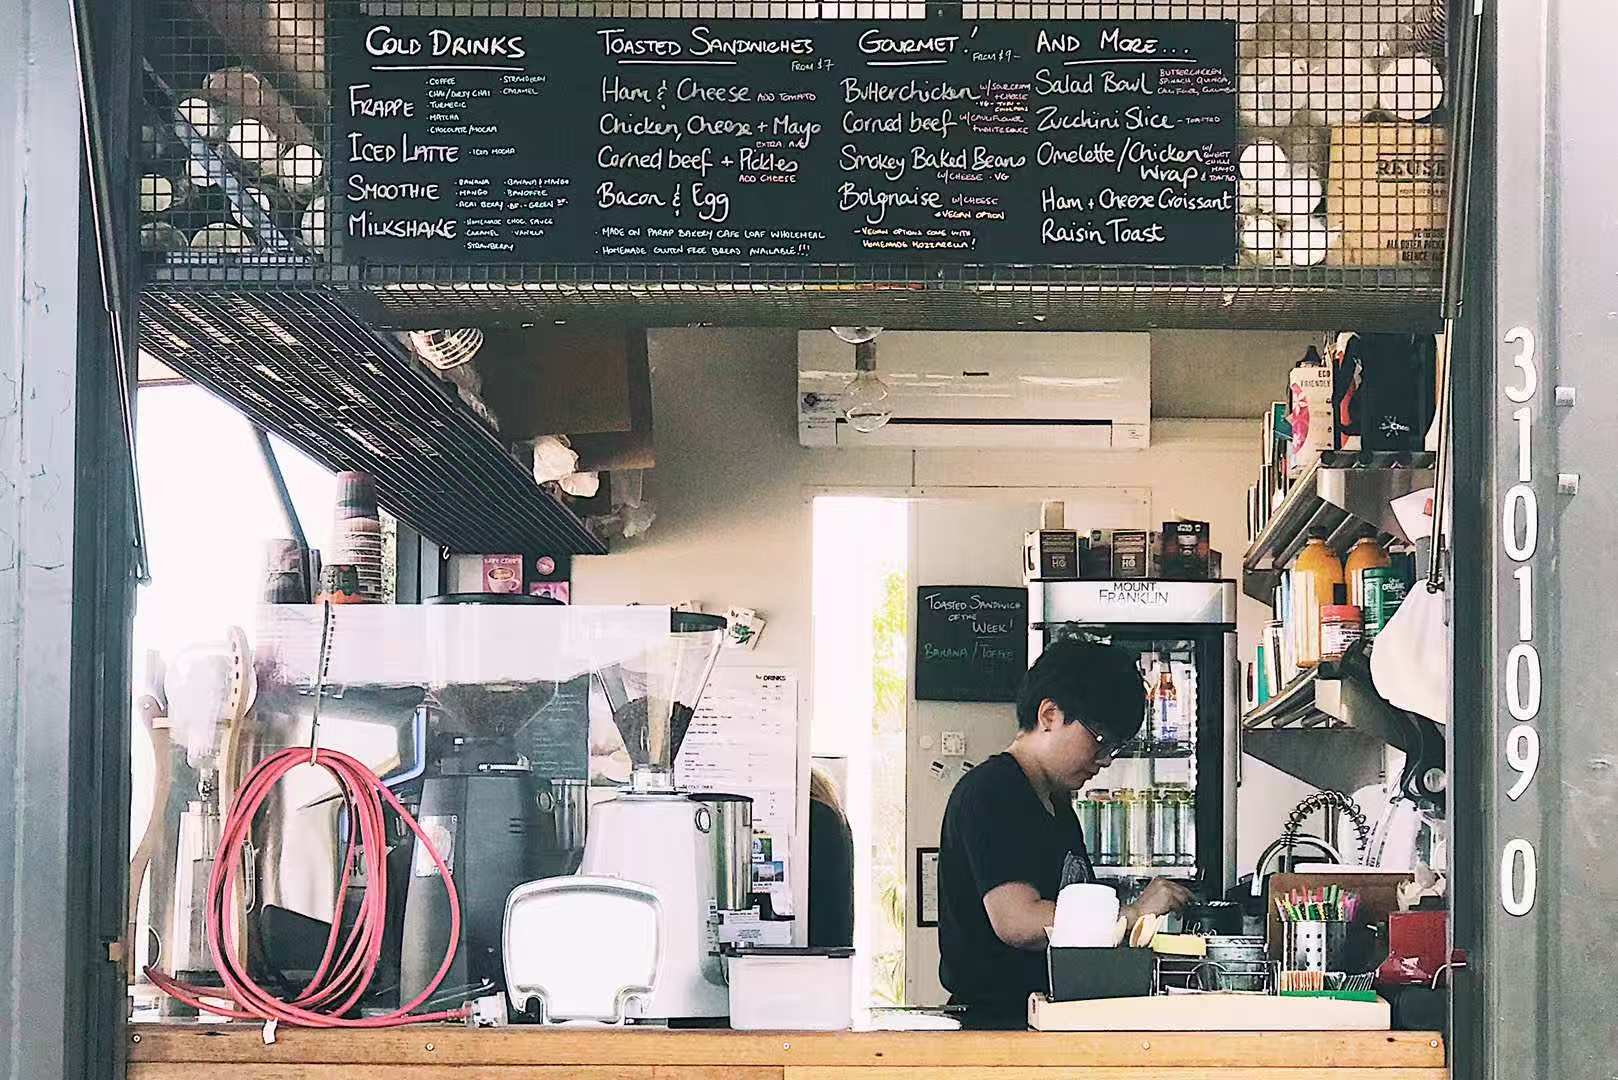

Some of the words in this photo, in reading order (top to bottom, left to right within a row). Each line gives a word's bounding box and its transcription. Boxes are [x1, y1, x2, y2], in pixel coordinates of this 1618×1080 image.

[366, 25, 422, 56] COLD
[428, 29, 526, 59] DRINKS
[597, 28, 682, 56] TOASTED
[689, 26, 814, 56] SANDWICHES
[1036, 30, 1081, 53] AND
[602, 75, 652, 103] Ham
[676, 77, 752, 103] Cheese
[1035, 68, 1094, 95] Salad
[1101, 70, 1154, 95] Bowl
[348, 83, 415, 118] FRAPPE
[686, 114, 753, 137] Cheese
[773, 114, 822, 149] Mayo
[842, 110, 902, 134] Corned
[908, 108, 959, 139] beef
[1035, 106, 1120, 132] Zucchini
[1124, 105, 1175, 130] Slice
[347, 132, 396, 163] ICED
[402, 132, 460, 164] LATTE
[597, 145, 662, 171] Corned
[668, 147, 714, 177] beef
[738, 147, 799, 172] Pickles
[839, 144, 906, 181] Smokey
[911, 146, 968, 170] Baked
[971, 146, 1026, 171] Beans
[1140, 164, 1199, 189] Wrap
[346, 173, 441, 201] SMOOTHIE
[1041, 186, 1084, 213] Ham
[1099, 188, 1155, 209] Cheese
[1157, 187, 1233, 211] Croissant
[596, 181, 666, 209] Bacon
[691, 182, 730, 223] Egg
[348, 210, 458, 240] MILKSHAKE
[602, 226, 625, 238] MADE
[627, 227, 641, 238] ON
[1041, 217, 1106, 245] Raisin
[1106, 217, 1165, 242] Toast
[924, 592, 967, 611] TOASTED
[1098, 589, 1169, 605] FRANKLIN
[1113, 582, 1157, 593] MOUNT
